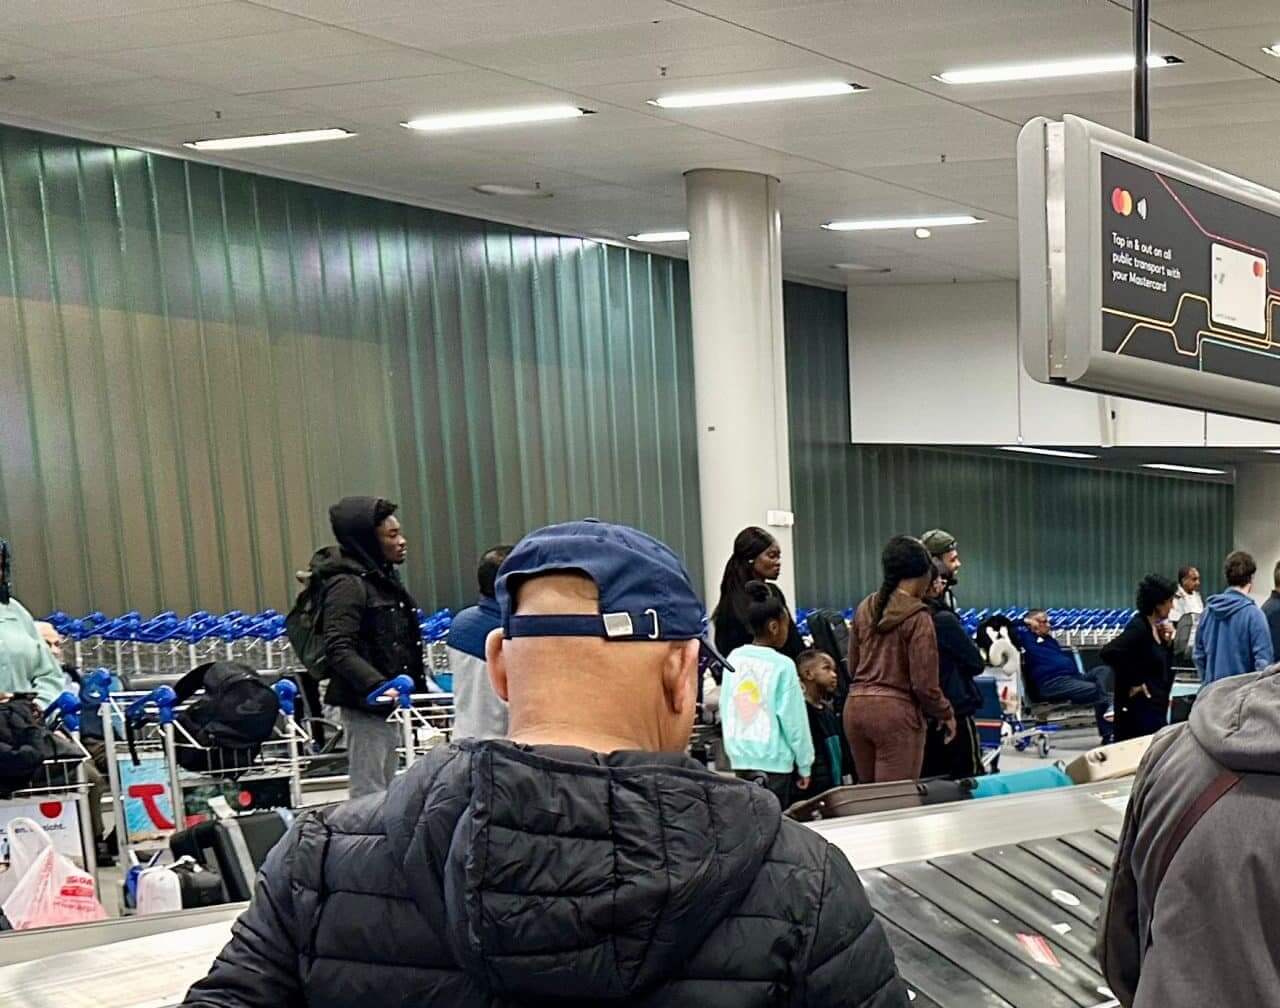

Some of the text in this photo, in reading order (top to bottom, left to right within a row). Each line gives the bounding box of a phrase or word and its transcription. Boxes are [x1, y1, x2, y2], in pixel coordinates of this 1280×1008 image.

[1112, 231, 1172, 260] Tap in & out on all
[1112, 251, 1181, 280] public transport with
[1112, 269, 1167, 292] your Mastercard
